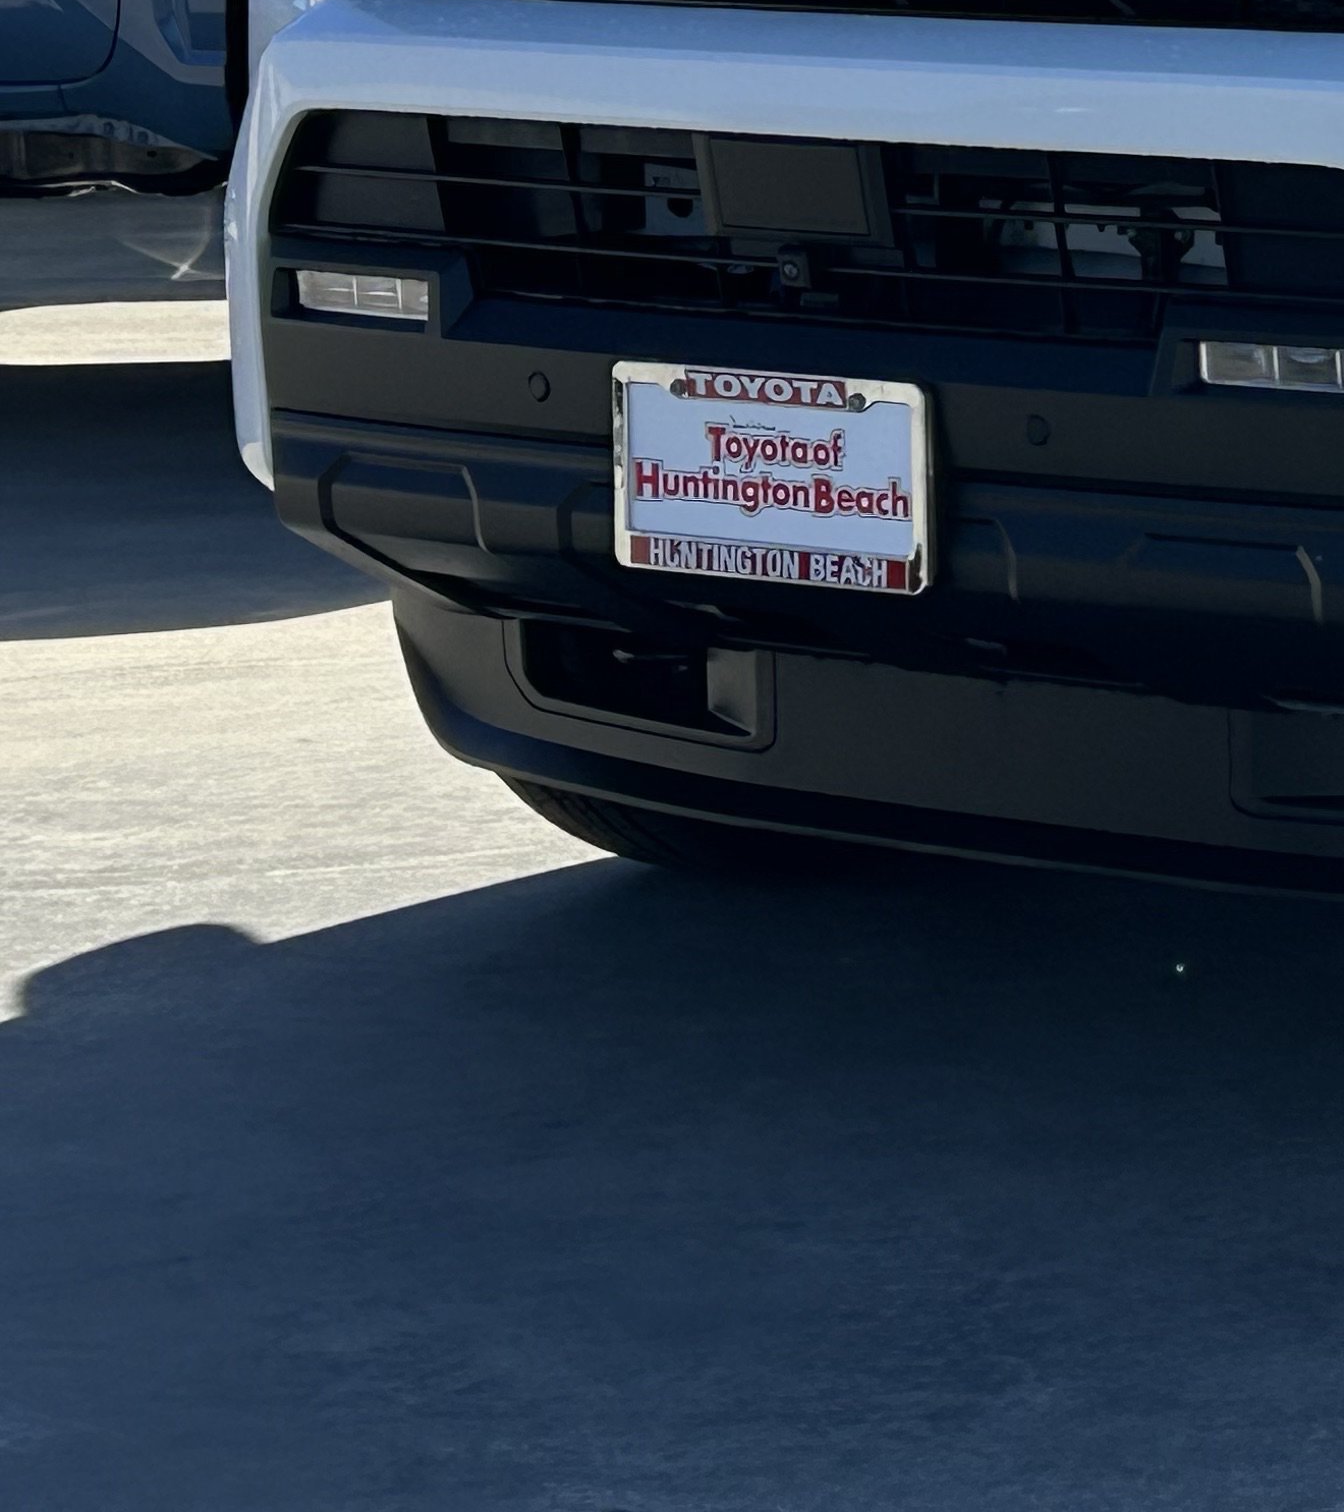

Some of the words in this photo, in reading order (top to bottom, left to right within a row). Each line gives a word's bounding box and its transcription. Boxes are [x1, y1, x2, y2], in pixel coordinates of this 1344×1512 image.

[687, 372, 844, 407] TOYOTA
[708, 426, 808, 471] Toyota
[809, 429, 842, 467] of
[635, 461, 811, 512] Huntington
[813, 478, 910, 518] Beach
[650, 538, 800, 580] HUNTINGTON
[809, 553, 888, 588] BEACH
